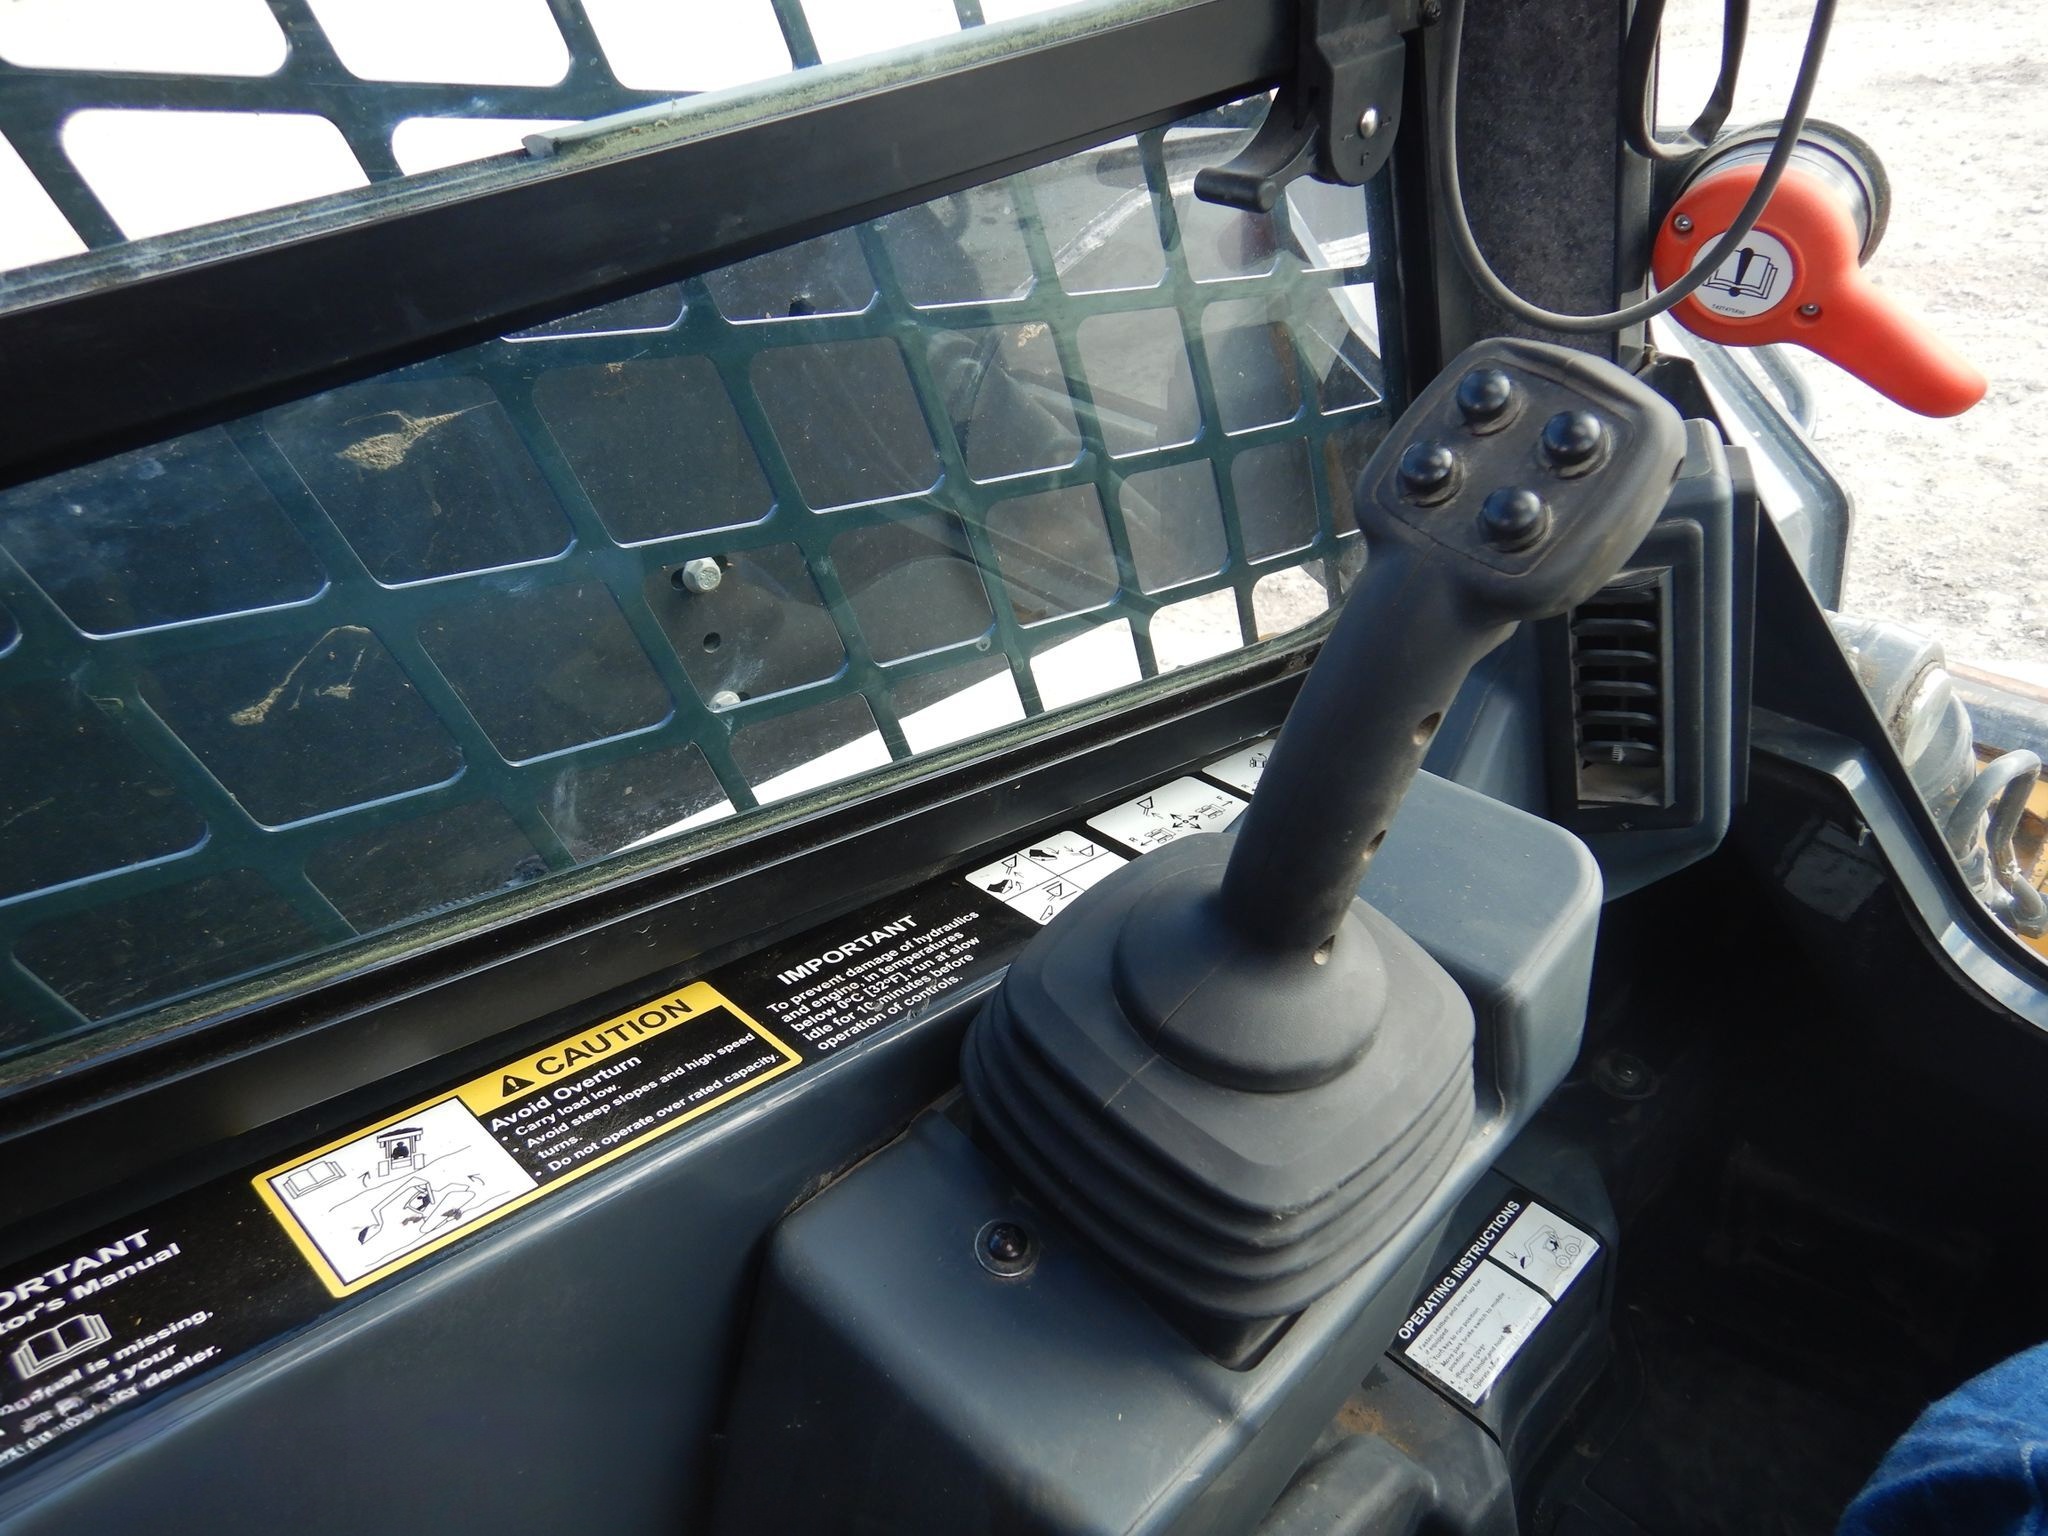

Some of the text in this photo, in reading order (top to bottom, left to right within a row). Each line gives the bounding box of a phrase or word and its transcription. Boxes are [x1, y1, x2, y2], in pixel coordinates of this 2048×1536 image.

[766, 911, 980, 1014] To prevent damage of hydraulics
[777, 915, 918, 985] IMPORTANT
[781, 931, 964, 1024] and engine, in temperatures
[791, 1006, 837, 1032] below
[911, 958, 935, 975] run
[935, 951, 950, 962] at
[949, 936, 980, 957] slow
[803, 1023, 833, 1041] idle
[835, 1010, 856, 1028] for
[878, 974, 931, 1005] minutes
[933, 953, 974, 978] before
[817, 976, 963, 1051] operation of controls.
[536, 999, 693, 1075] CAUTION
[491, 1054, 642, 1132] Avoid Overturn
[515, 1083, 621, 1137] Carry load low.
[527, 1032, 755, 1150] Avoid steep slopes and high speed
[548, 1053, 779, 1172] Do not operate over rated capacity.
[537, 1135, 583, 1161] turns.
[70, 1242, 181, 1301] Manual
[1398, 1200, 1521, 1340] OPERATING INSTRUCTIONS
[88, 1358, 110, 1375] is
[114, 1310, 214, 1361] missing,
[121, 1345, 176, 1379] your
[145, 1345, 221, 1389] dealer.
